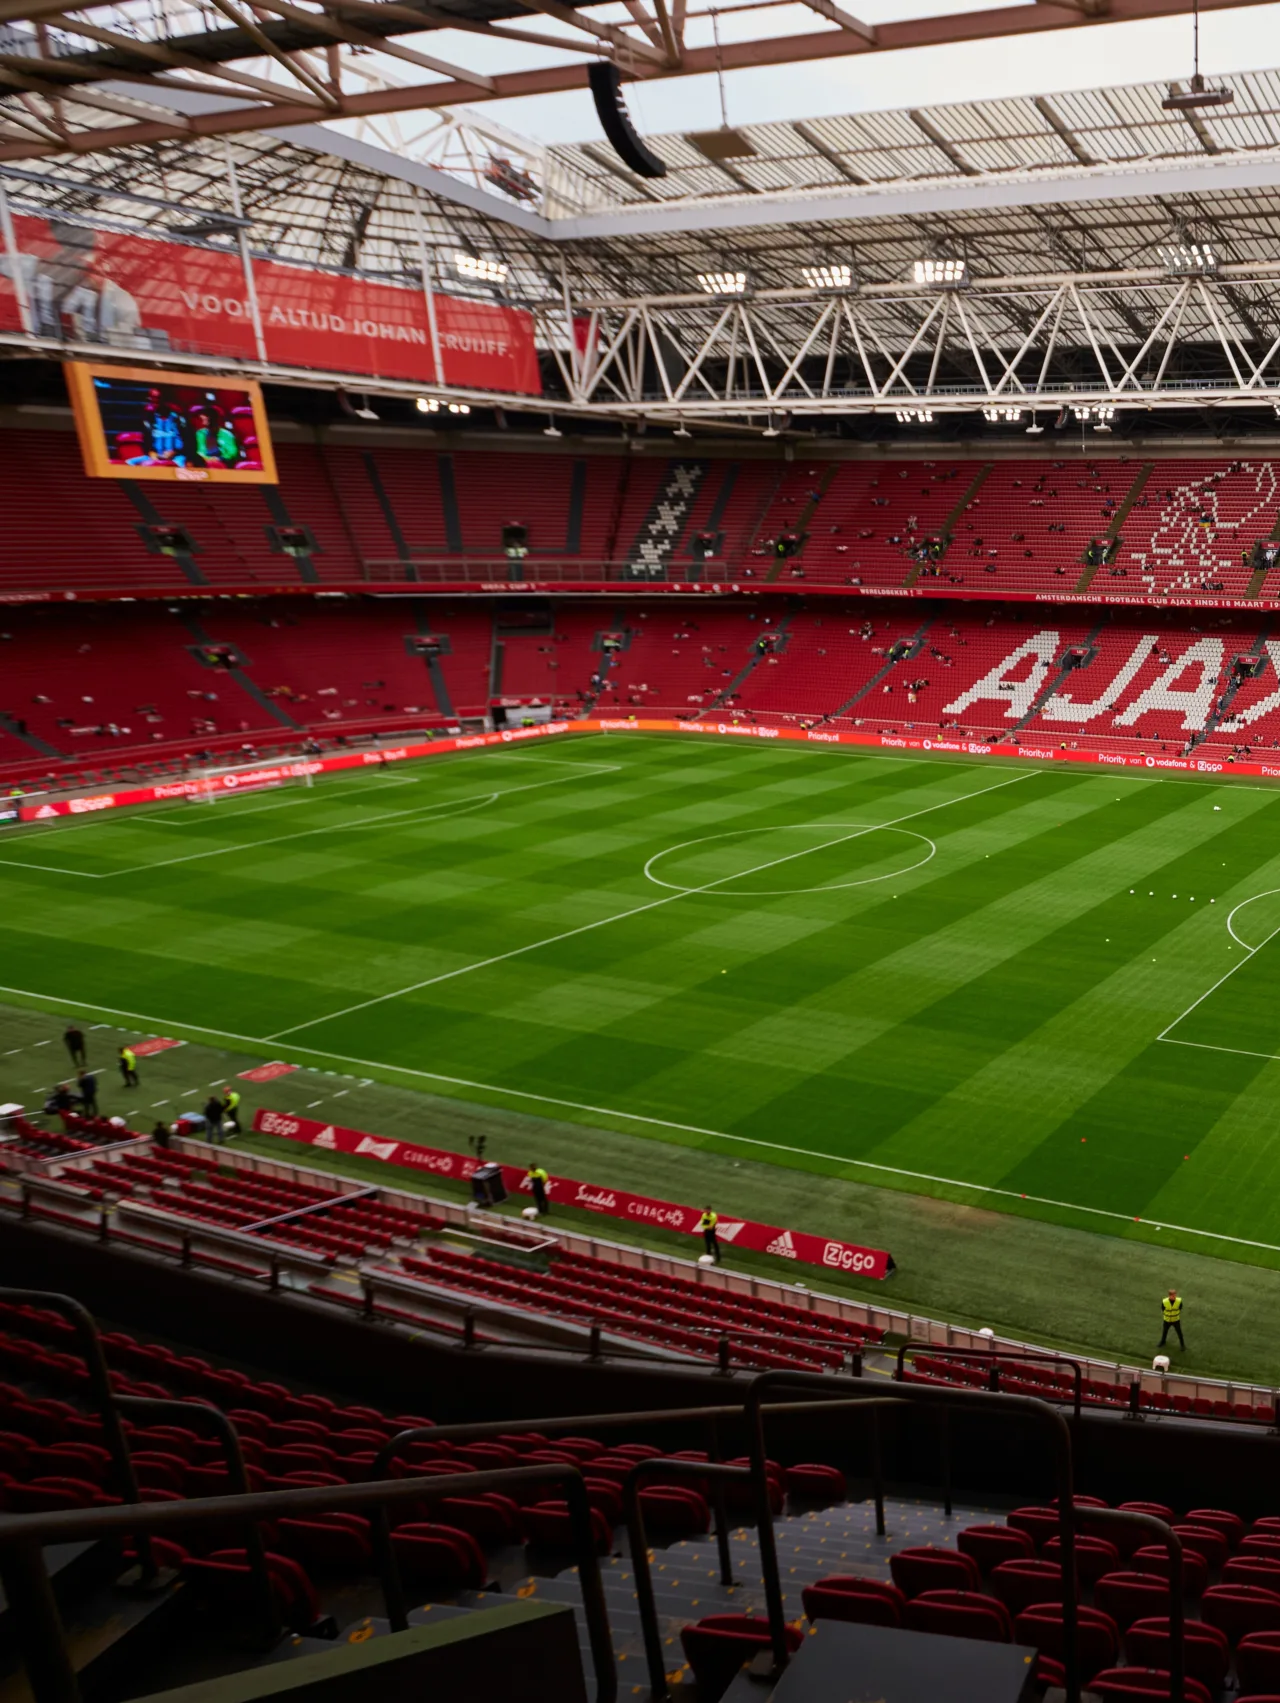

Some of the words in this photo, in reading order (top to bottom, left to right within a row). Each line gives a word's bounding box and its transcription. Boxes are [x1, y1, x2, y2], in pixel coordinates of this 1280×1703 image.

[353, 318, 427, 345] JOHAN
[860, 588, 909, 596] WERELDBEKER
[1035, 594, 1102, 602] AMSTERDAMSCHE
[1105, 596, 1145, 604] FOOTBALL
[1147, 597, 1167, 605] CLUB
[1234, 600, 1264, 608] MAART
[679, 722, 704, 732] Priority
[725, 726, 751, 735] vodafone
[807, 731, 839, 743] Priority.nl
[881, 736, 907, 748] Priority
[932, 741, 960, 751] vodafone
[962, 743, 967, 751] &
[968, 743, 991, 754] Ziggo
[1018, 747, 1054, 759] Priority.nl
[1098, 754, 1126, 766] Priority
[1156, 759, 1187, 768] vodafone
[1190, 760, 1195, 768] &
[1197, 760, 1223, 772] Ziggo
[260, 1112, 299, 1135] Ziggo
[766, 1243, 797, 1259] adidas
[823, 1242, 875, 1272] Ziggo
